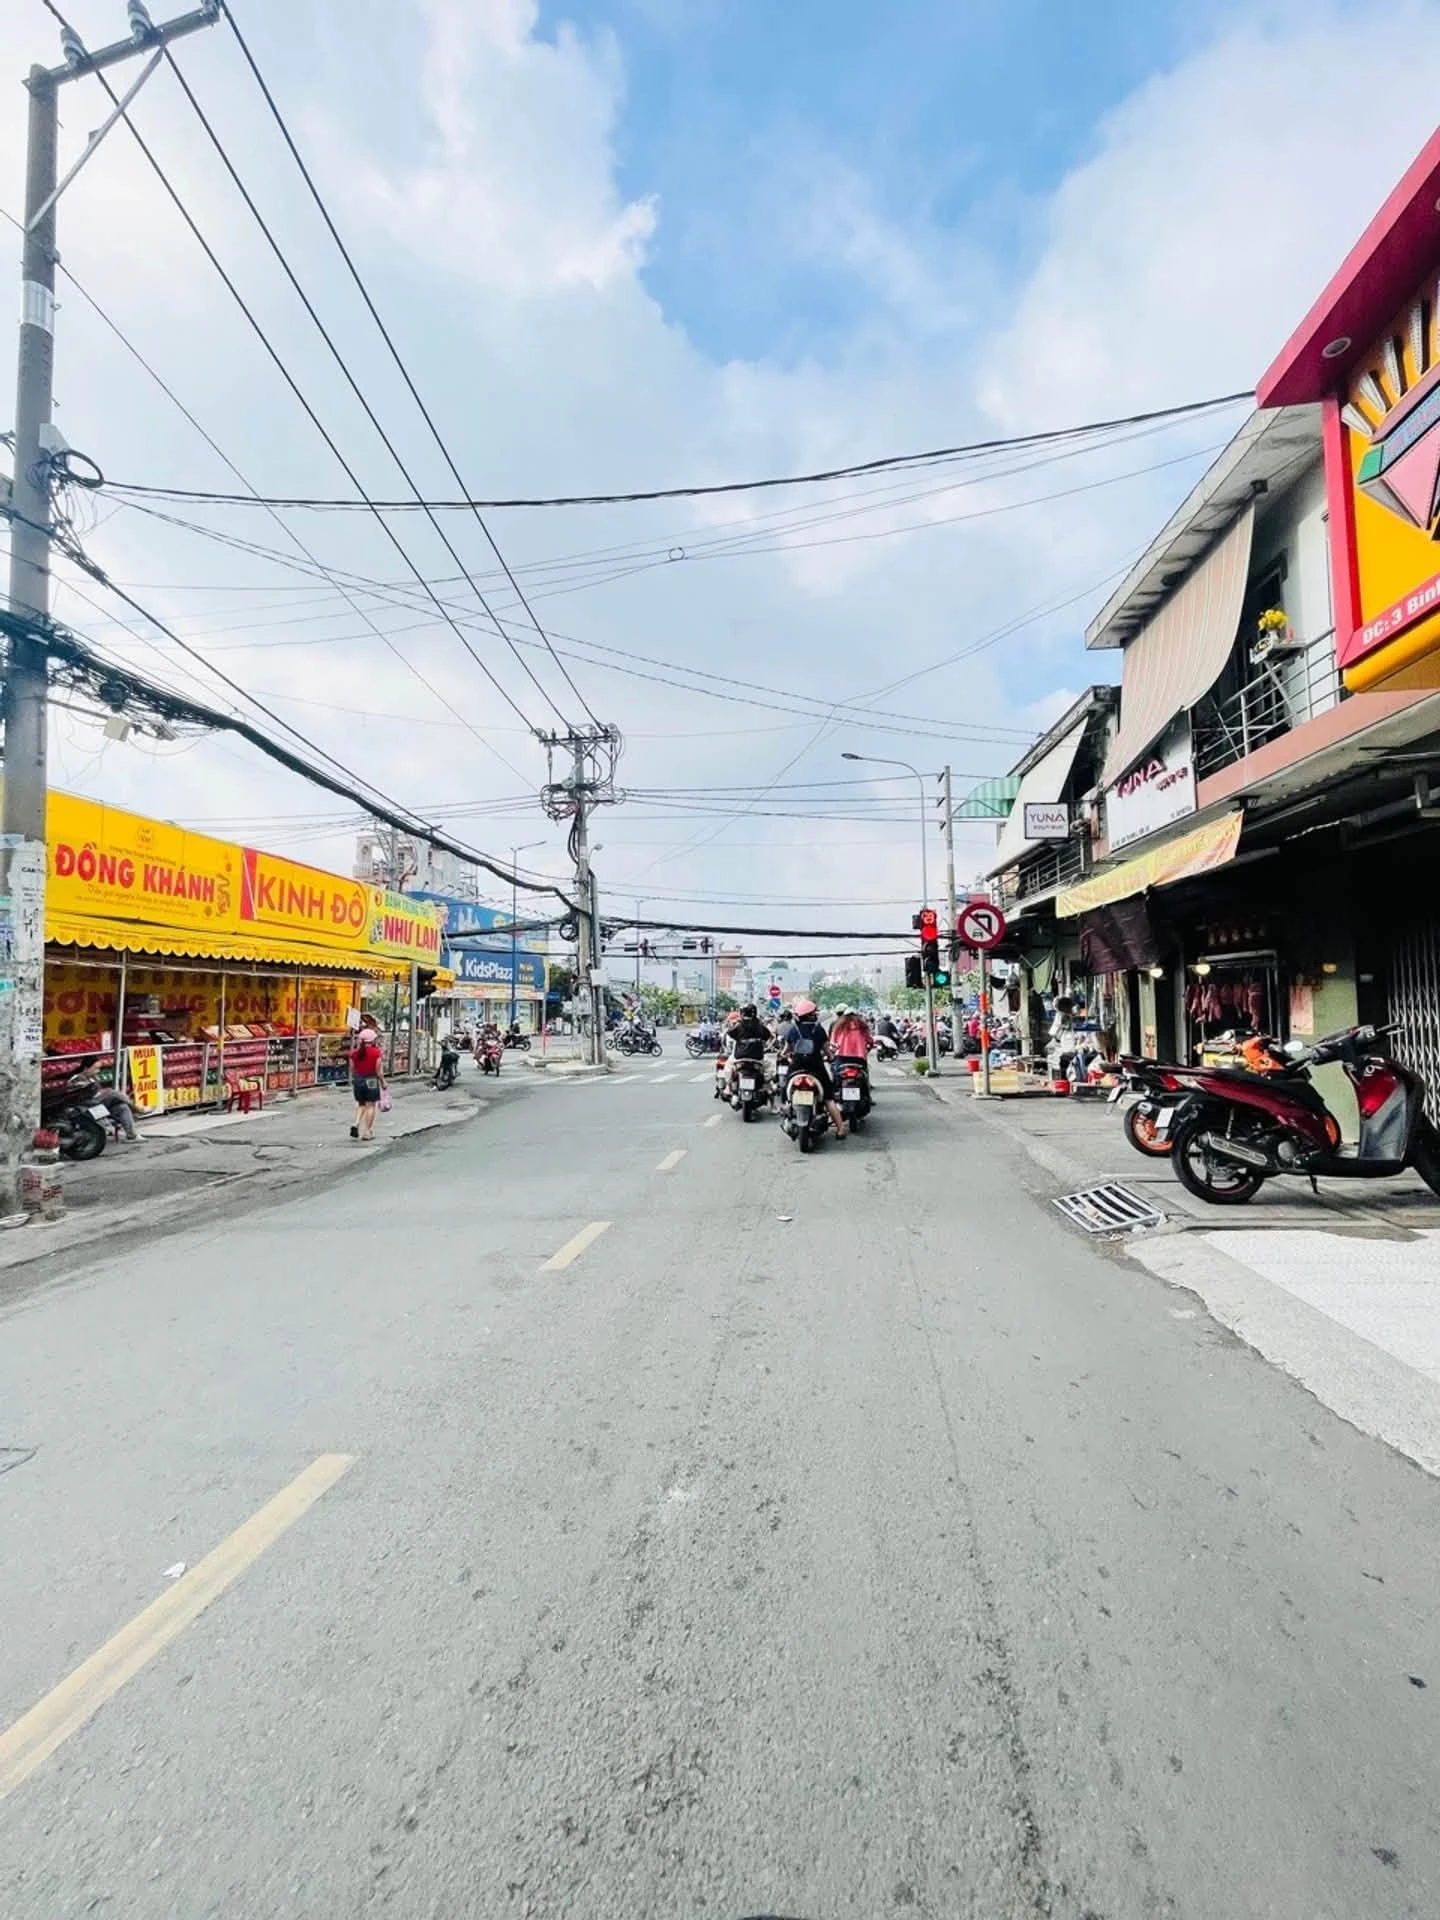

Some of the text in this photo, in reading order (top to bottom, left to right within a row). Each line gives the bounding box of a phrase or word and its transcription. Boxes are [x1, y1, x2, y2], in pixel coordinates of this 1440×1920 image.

[1391, 607, 1402, 625] 3
[55, 842, 135, 889] ĐỒNG
[143, 865, 215, 903] KHÁNH
[257, 873, 325, 920] KINH
[330, 892, 364, 928] ĐÔ
[384, 914, 438, 951] NHƯ LAN
[133, 1047, 156, 1059] MUA
[138, 1059, 151, 1079] 1
